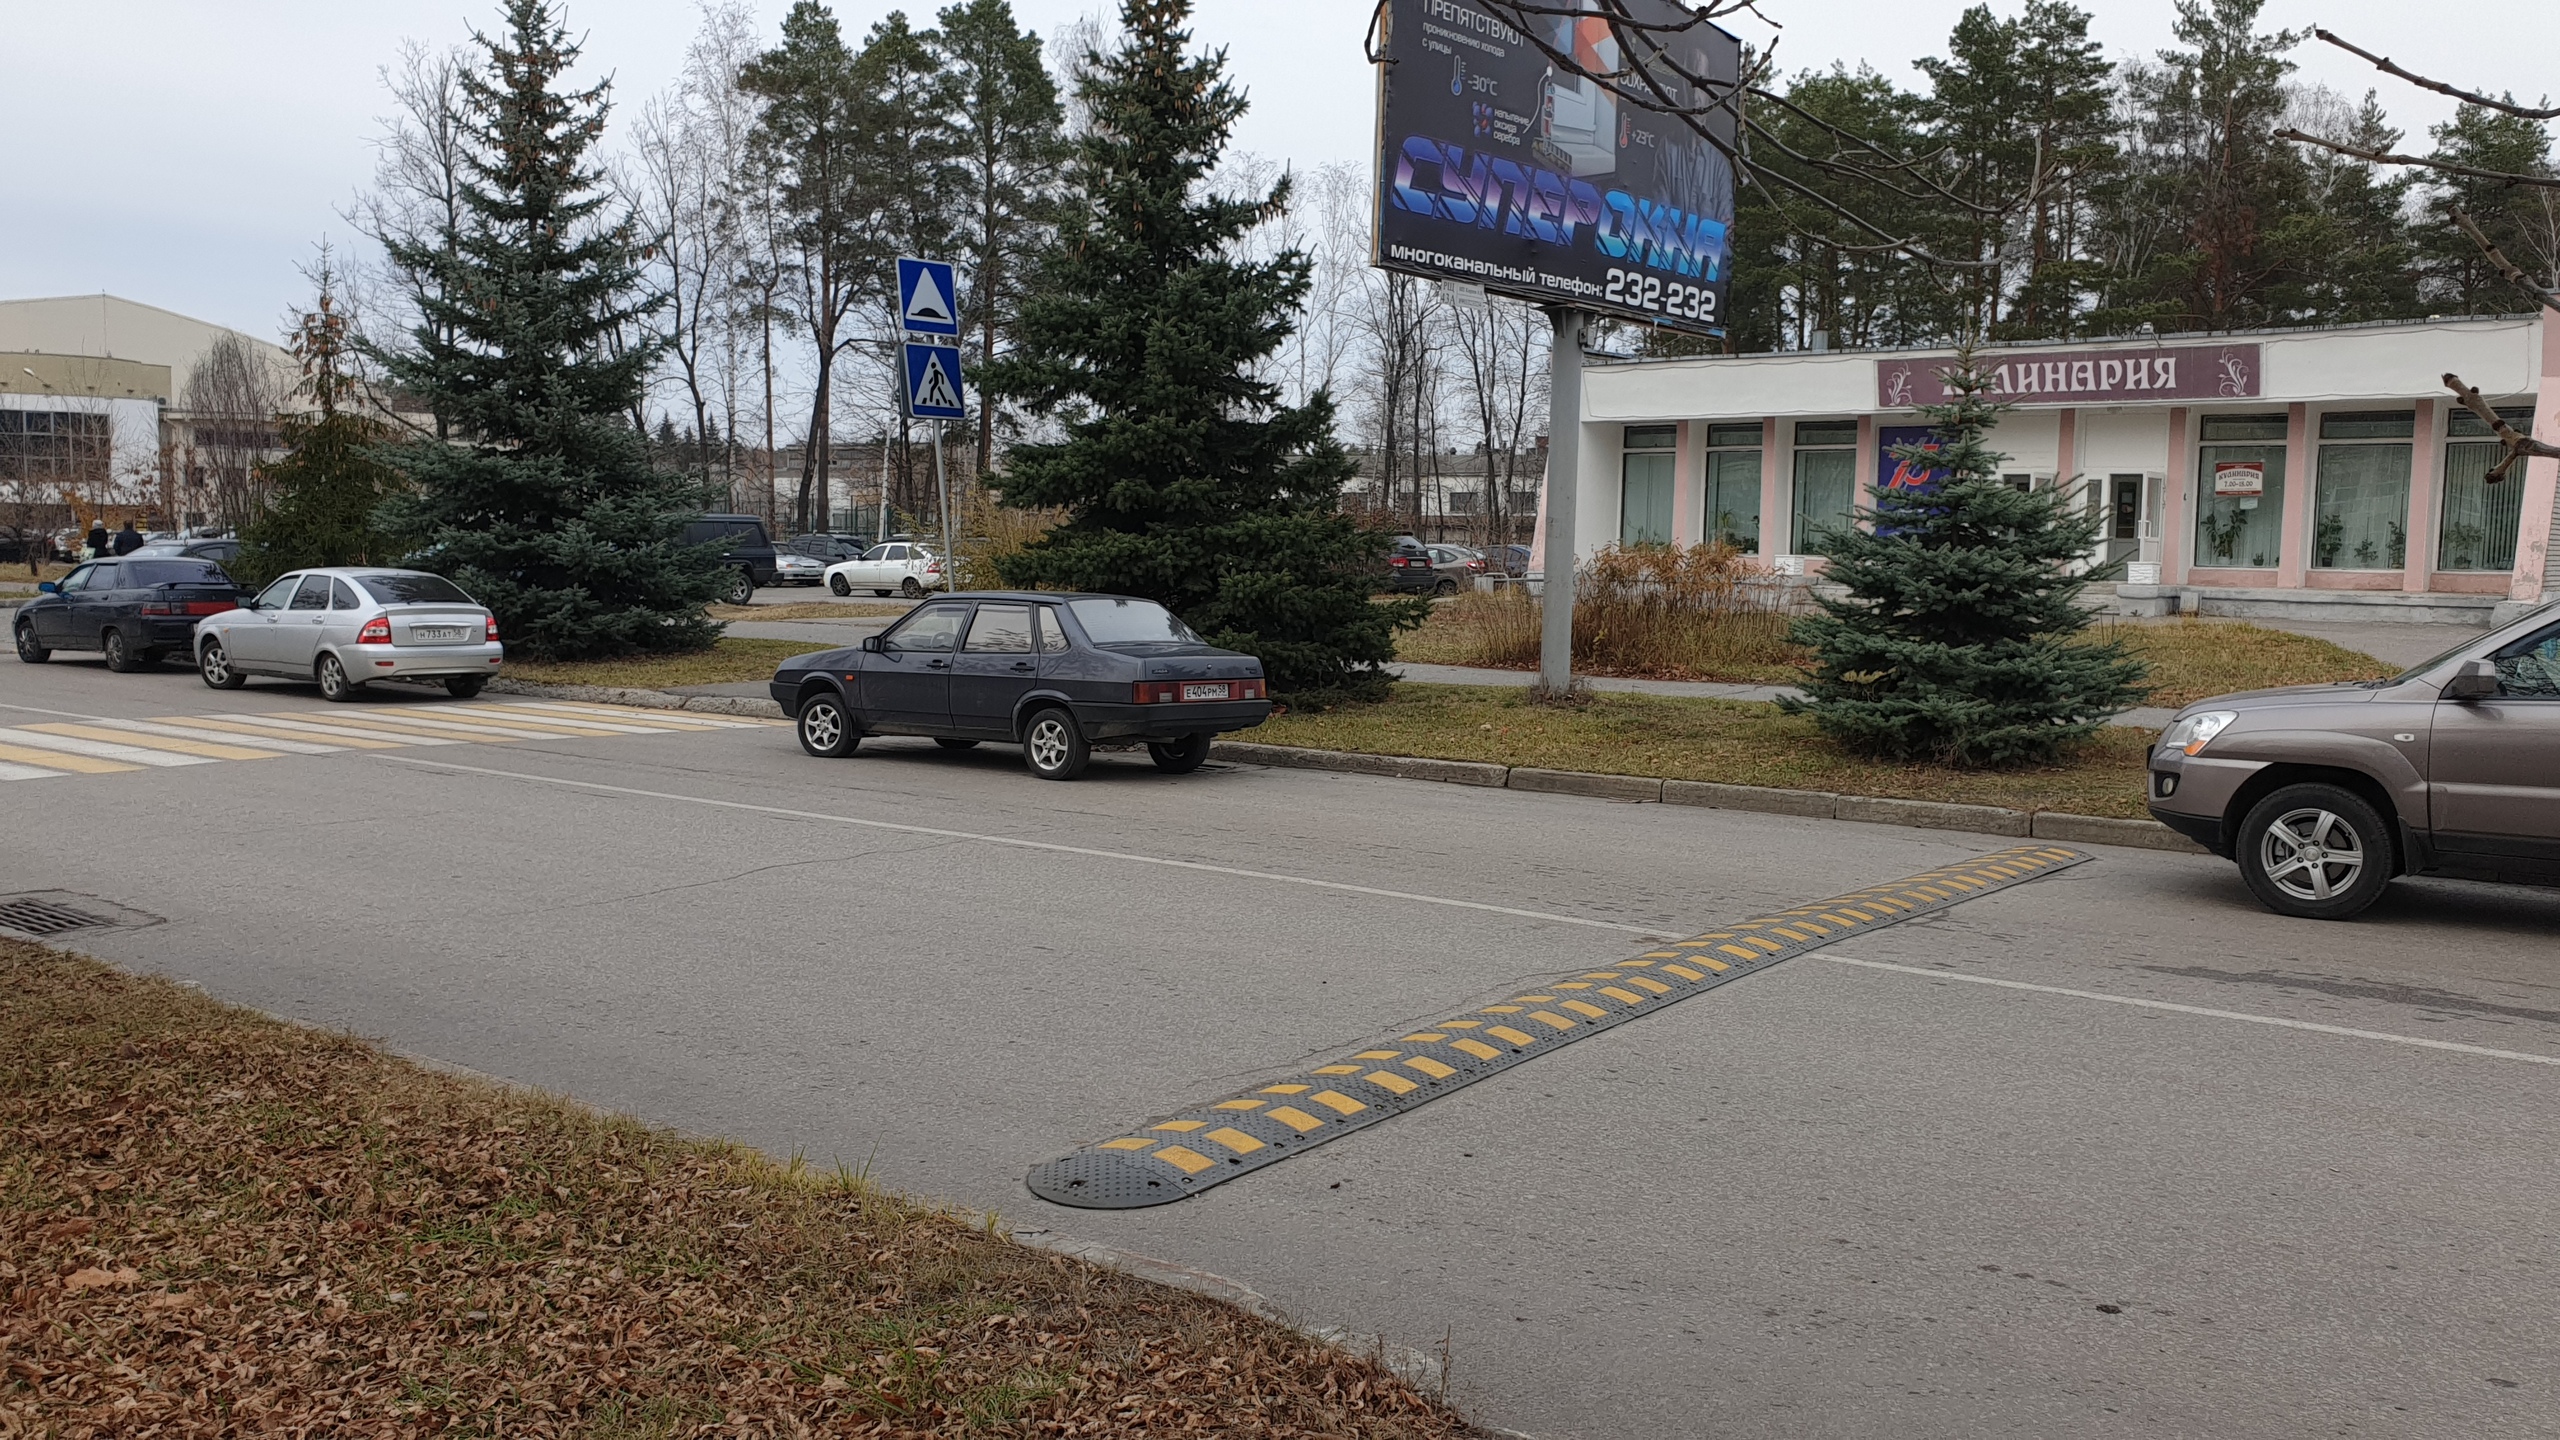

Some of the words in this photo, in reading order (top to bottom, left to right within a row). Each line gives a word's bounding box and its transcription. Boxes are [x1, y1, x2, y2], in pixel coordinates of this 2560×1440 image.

[1423, 22, 1480, 49] проникновению
[1480, 42, 1505, 57] холода
[1428, 40, 1452, 55] улицы
[1391, 244, 1536, 284] многоканальный
[1539, 272, 1604, 298] телефон:
[1605, 267, 1716, 323] 232-232
